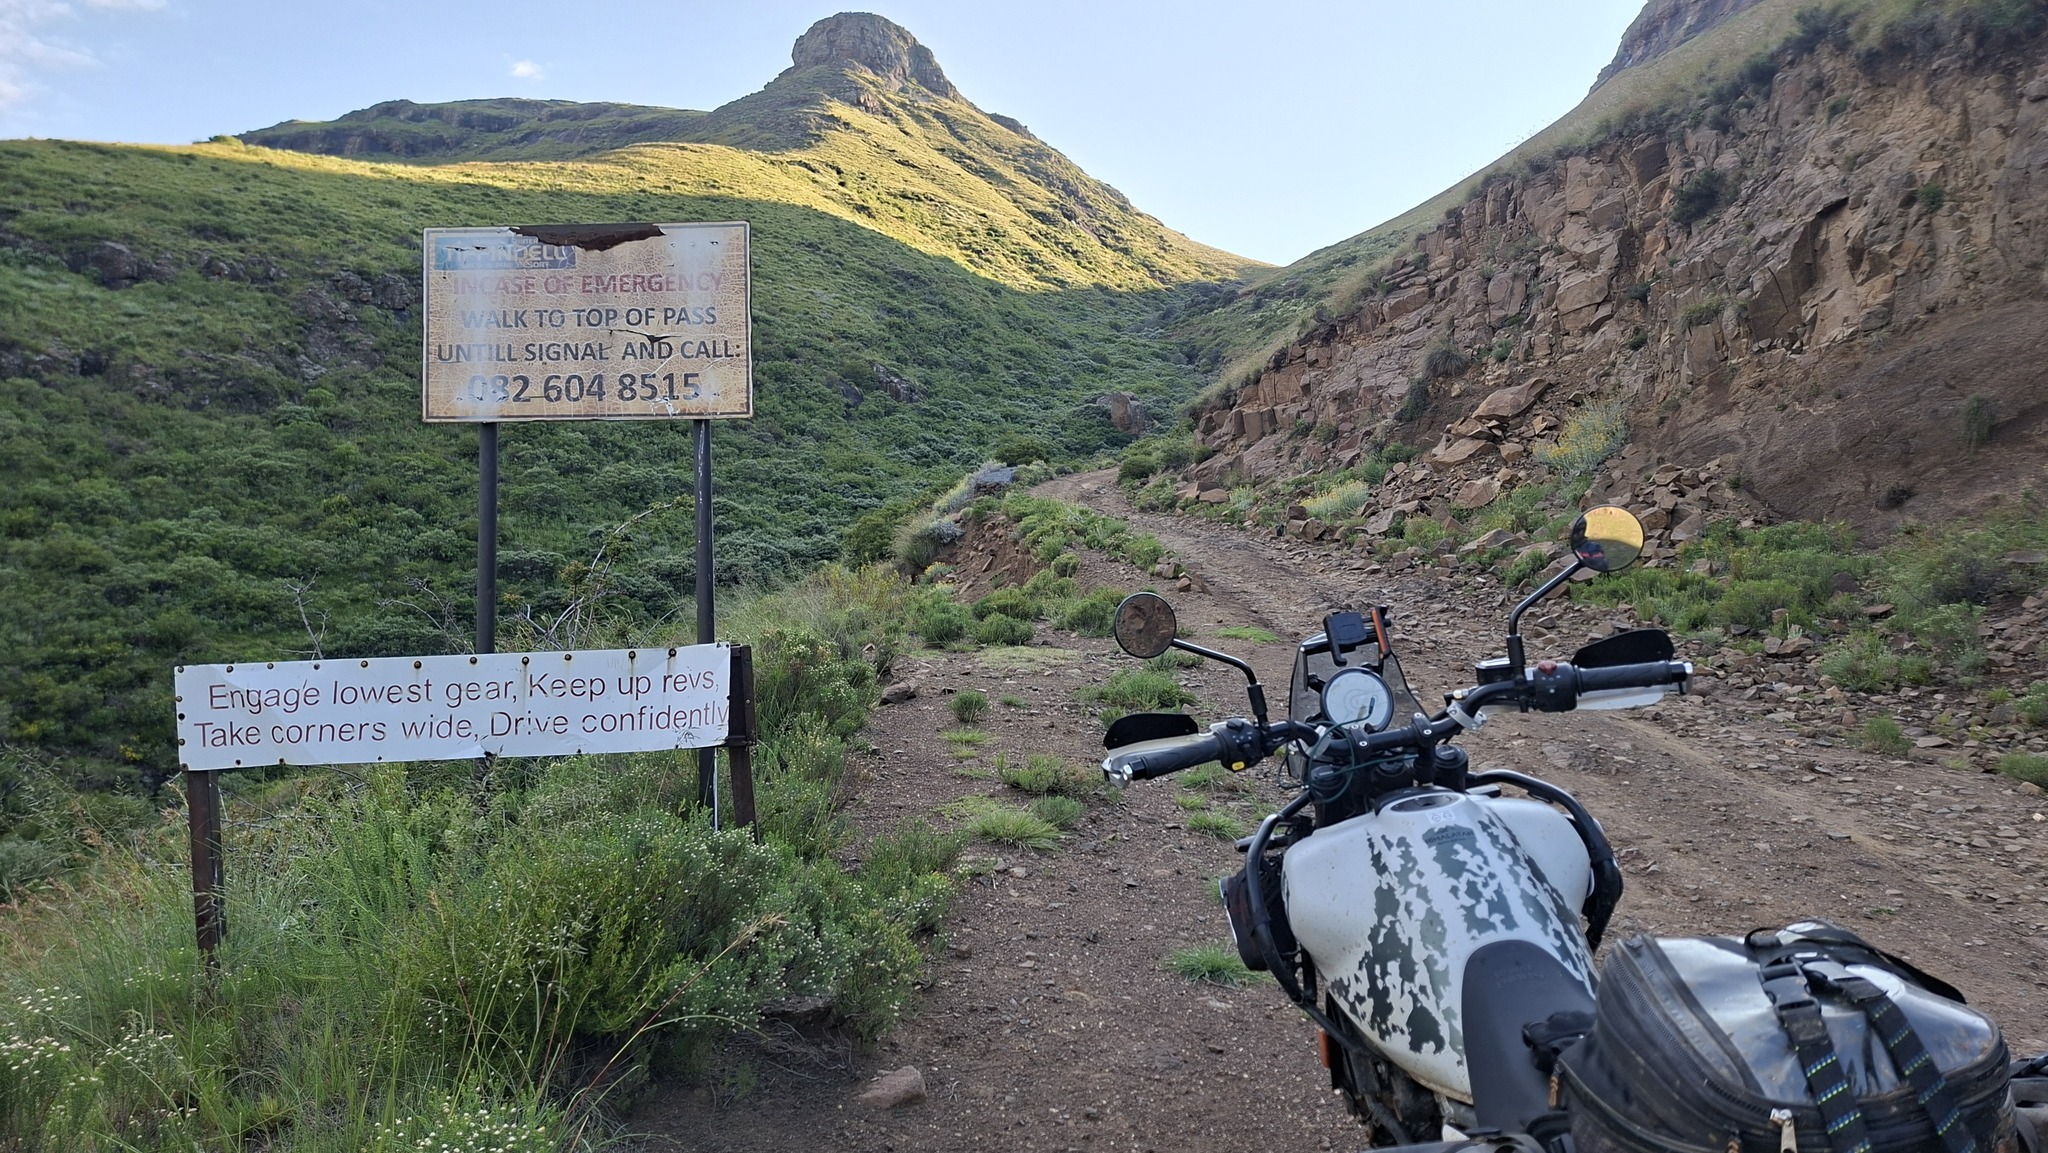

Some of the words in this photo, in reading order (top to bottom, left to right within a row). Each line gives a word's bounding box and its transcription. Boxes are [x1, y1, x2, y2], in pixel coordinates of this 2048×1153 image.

[543, 275, 575, 294] OF
[581, 272, 723, 294] EMERGENCY
[461, 309, 528, 328] WALK
[534, 309, 566, 328] TO
[572, 308, 618, 328] TOP
[625, 308, 656, 327] OF
[663, 307, 717, 326] PASS
[437, 342, 517, 362] UNTILL
[524, 342, 609, 361] SIGNAL
[622, 341, 673, 360] AND
[680, 340, 741, 359] CALL:
[467, 374, 531, 403] 082
[543, 374, 606, 403] 604
[617, 372, 701, 402] 8515
[209, 684, 320, 715] Engage
[332, 679, 433, 705] lowest
[445, 679, 517, 709] gear,
[529, 672, 606, 702] Keep
[617, 675, 652, 701] up
[662, 670, 719, 693] revs,
[194, 720, 262, 748] Take
[271, 721, 387, 745] corners
[401, 713, 479, 741] wide,
[490, 710, 569, 737] Drive
[581, 700, 729, 734] confidently
